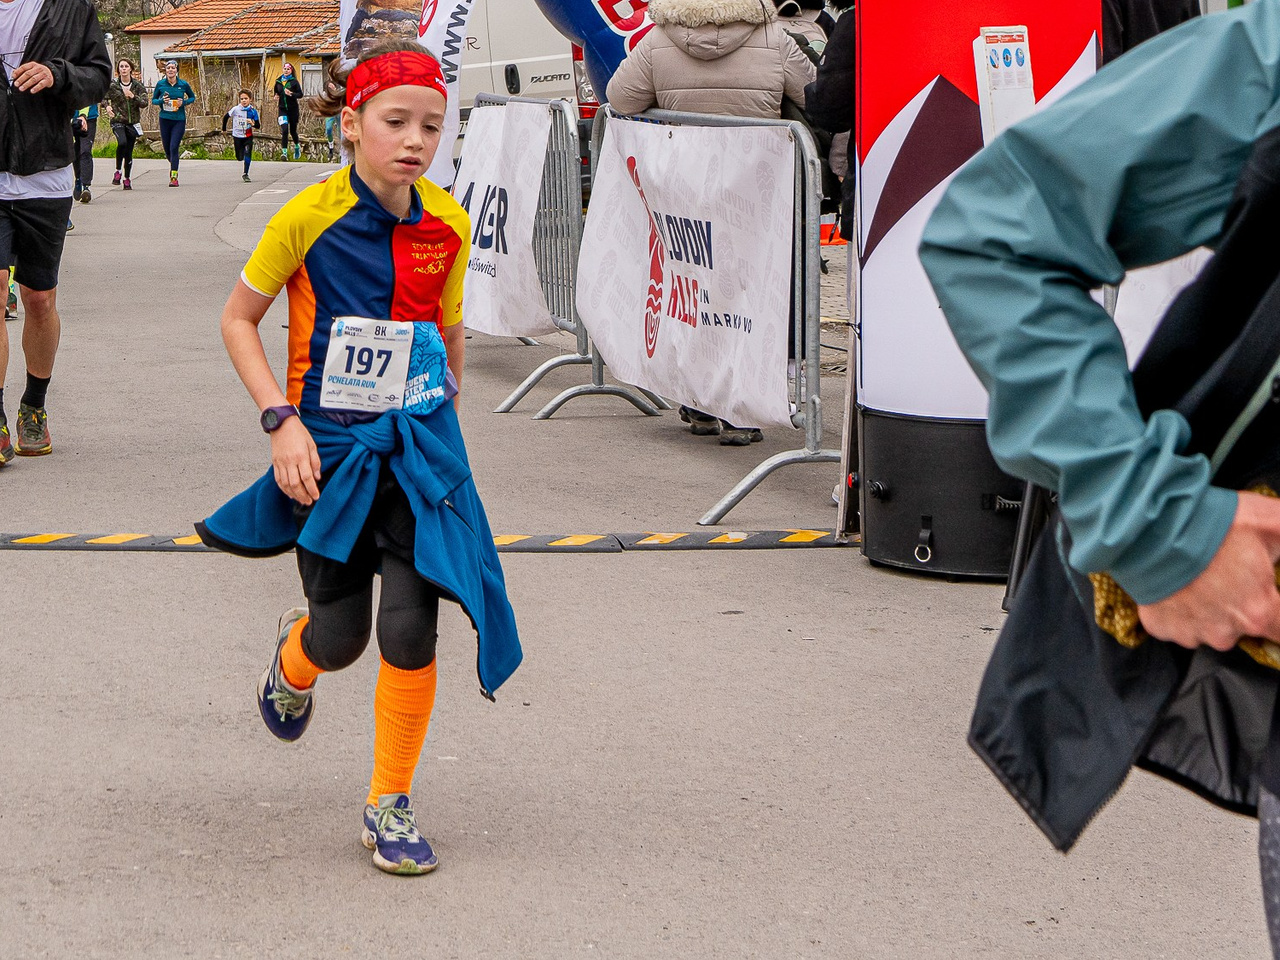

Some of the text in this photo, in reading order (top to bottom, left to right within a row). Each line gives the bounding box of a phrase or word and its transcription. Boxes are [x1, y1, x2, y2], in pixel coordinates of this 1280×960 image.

[530, 73, 571, 83] DUCATO
[700, 288, 710, 305] IN
[374, 325, 388, 337] 8K
[344, 344, 393, 378] 197
[361, 378, 377, 389] RUN
